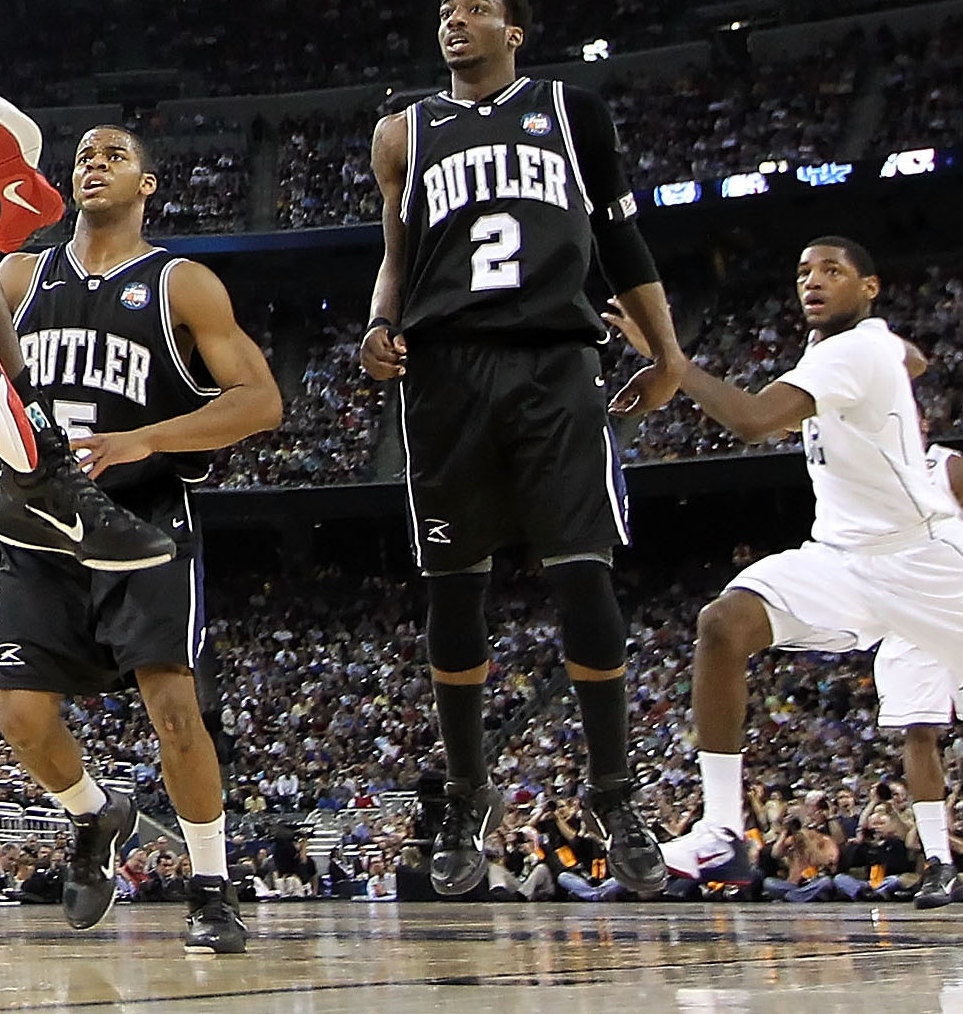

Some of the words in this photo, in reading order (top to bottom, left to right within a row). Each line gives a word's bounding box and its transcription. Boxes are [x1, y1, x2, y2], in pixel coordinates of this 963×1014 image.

[423, 143, 568, 228] BUTLER
[469, 212, 522, 292] 2
[19, 327, 151, 406] BUTLER
